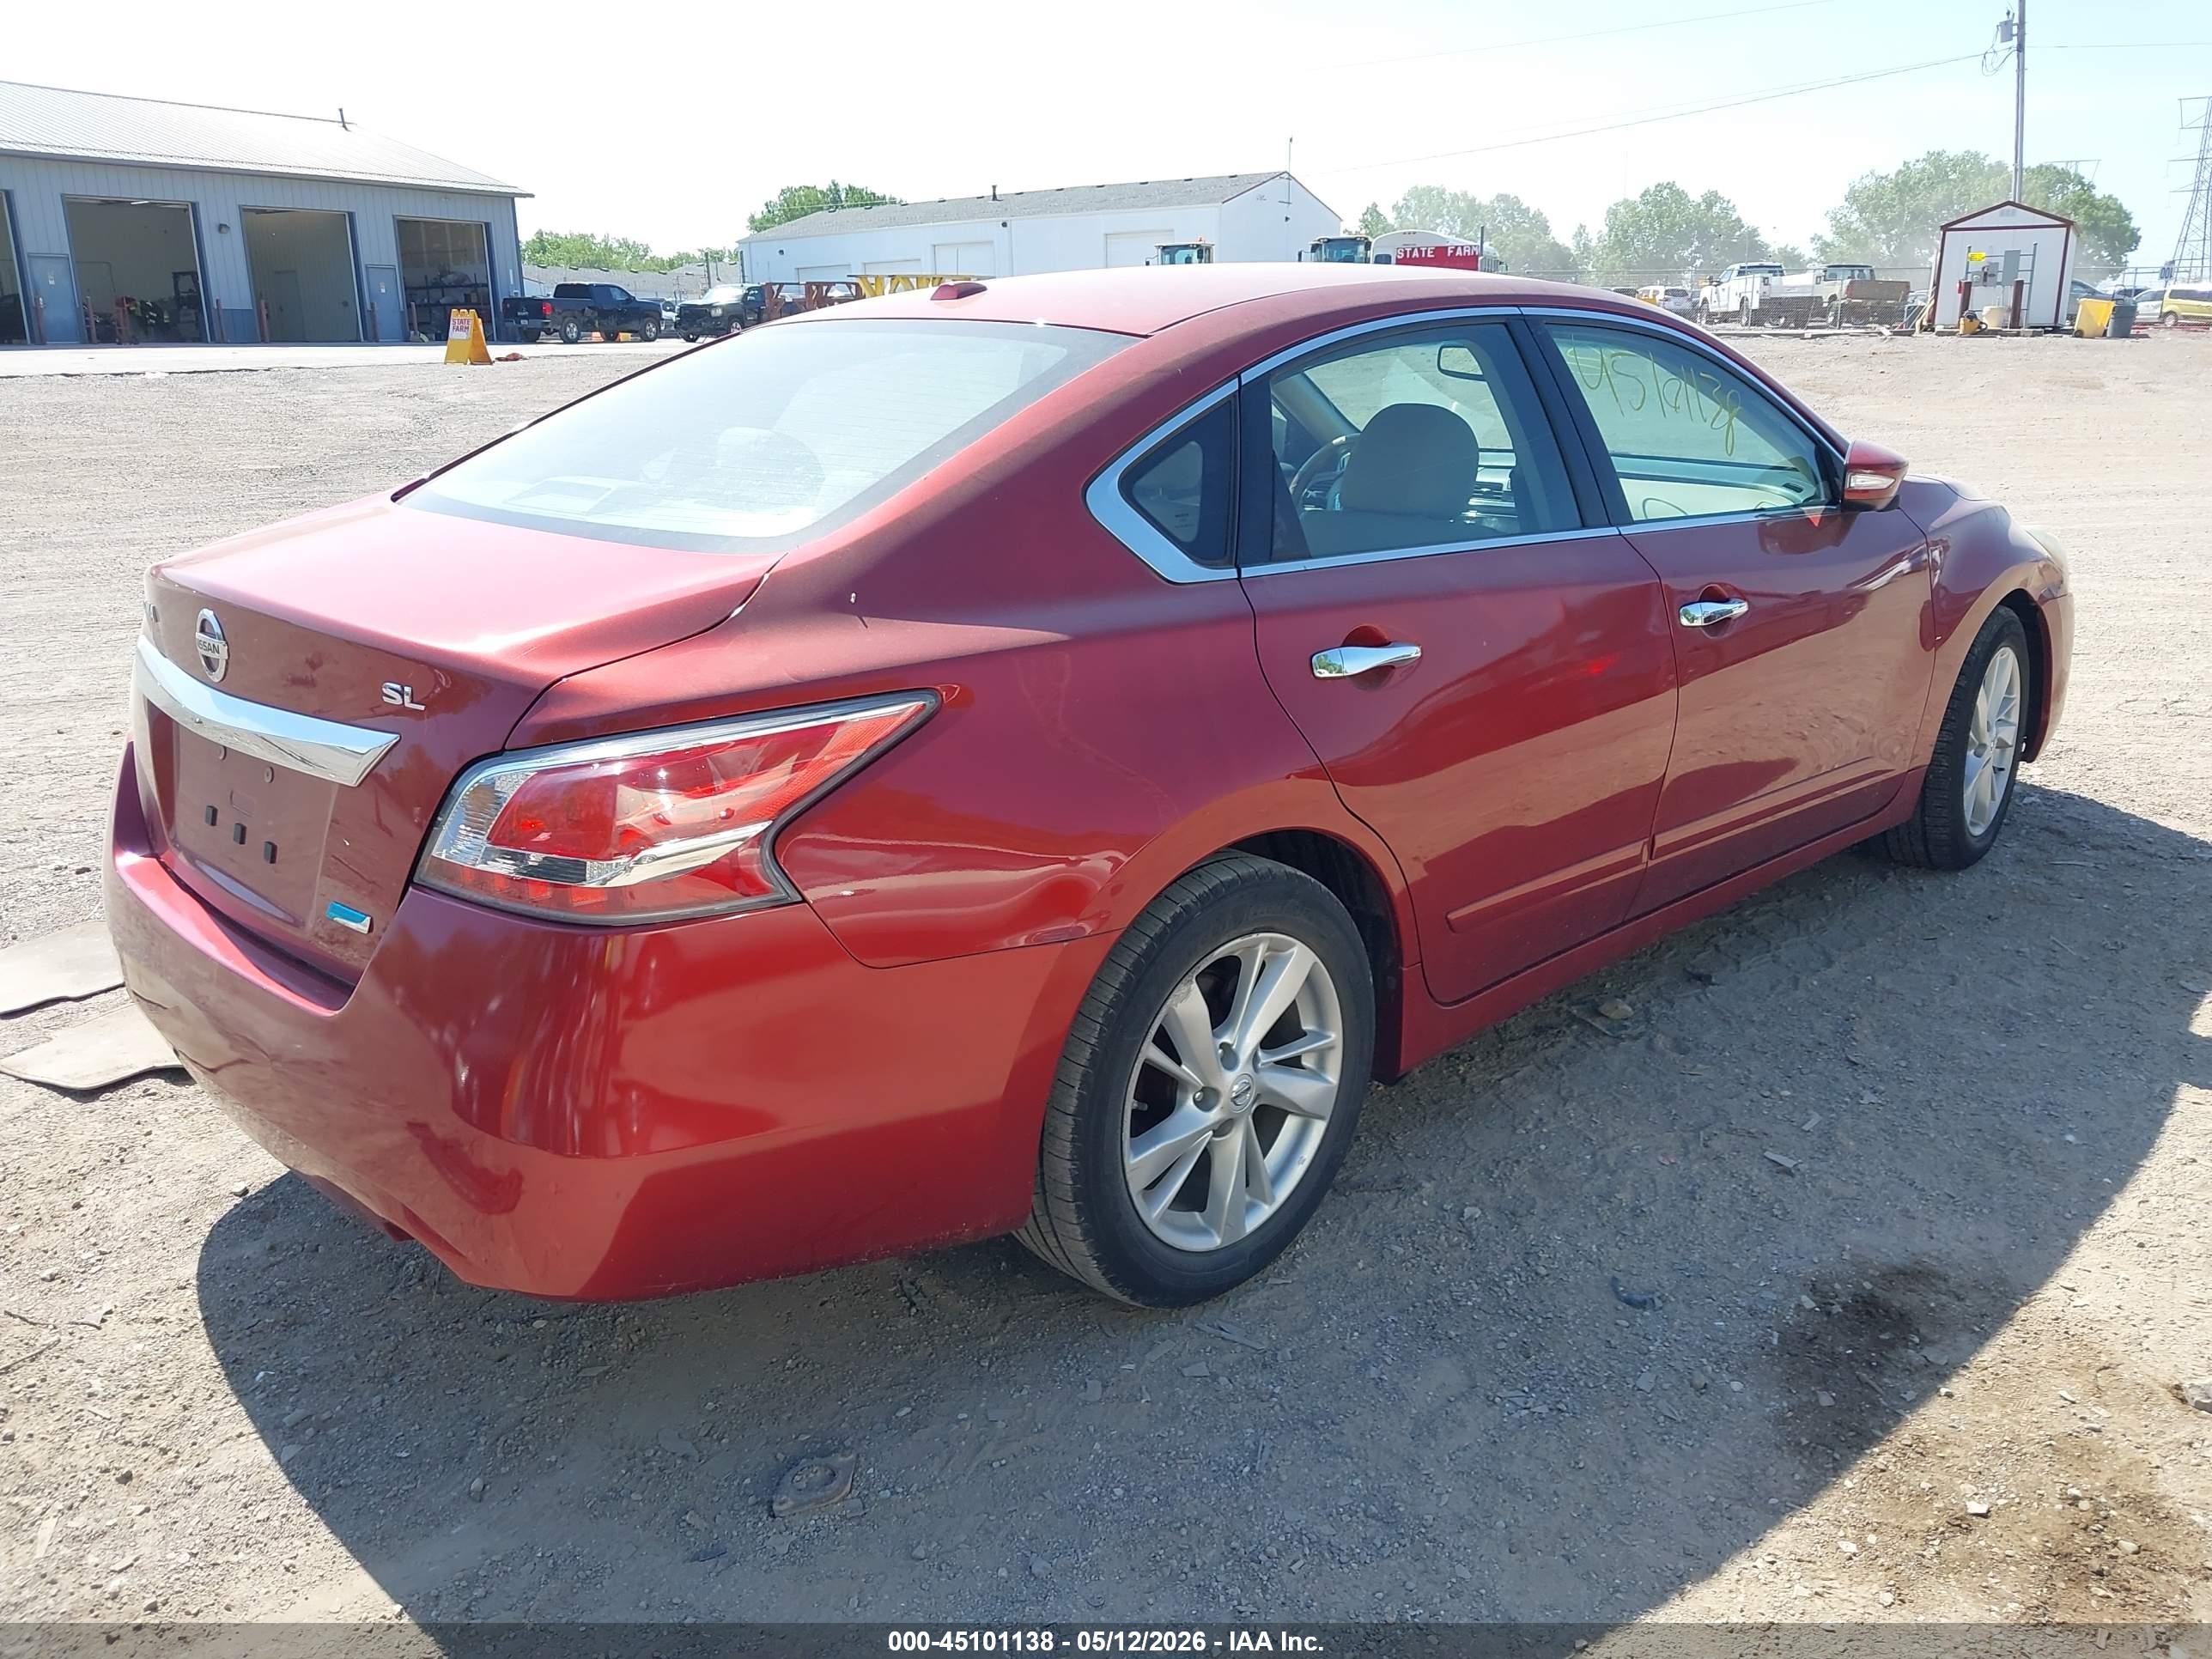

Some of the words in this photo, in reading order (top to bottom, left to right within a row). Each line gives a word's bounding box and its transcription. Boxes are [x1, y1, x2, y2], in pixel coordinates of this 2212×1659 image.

[1396, 247, 1435, 258] STATE
[1447, 246, 1478, 257] FARM
[197, 638, 221, 655] ISSAN
[381, 682, 426, 711] SL
